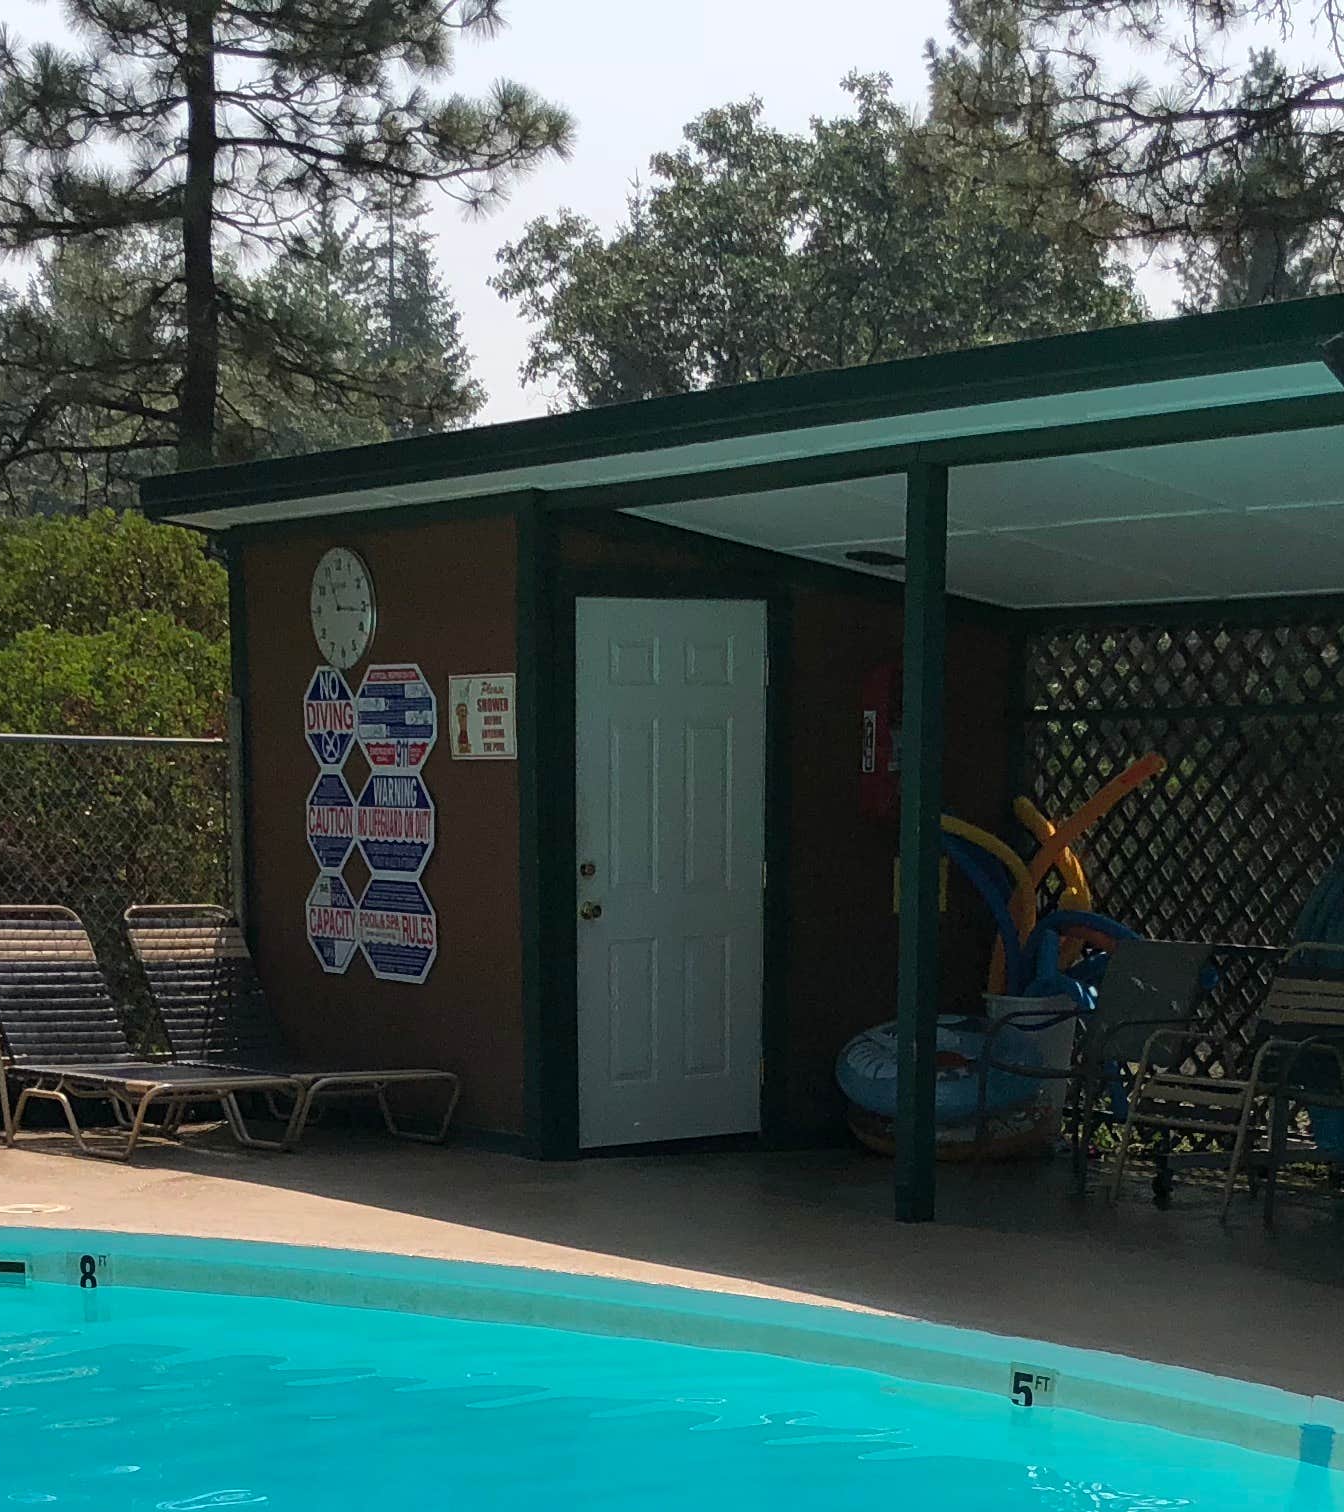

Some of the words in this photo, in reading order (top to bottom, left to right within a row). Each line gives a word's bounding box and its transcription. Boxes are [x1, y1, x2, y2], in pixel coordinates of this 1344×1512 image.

[319, 672, 339, 700] NO
[481, 681, 504, 696] Please
[306, 702, 354, 730] DIVING
[477, 698, 509, 713] SHOWER
[396, 740, 409, 767] 911
[373, 777, 417, 807] WARNING
[308, 807, 353, 833] CAUTION
[358, 808, 368, 837] NO
[368, 809, 403, 838] LIFEGUARD
[404, 810, 414, 838] ON
[415, 810, 431, 839] DUTY
[309, 908, 355, 939] CAPACITY
[402, 915, 434, 945] RULES
[79, 1254, 97, 1288] 8
[1011, 1371, 1034, 1406] 5
[1035, 1375, 1051, 1392] FT
